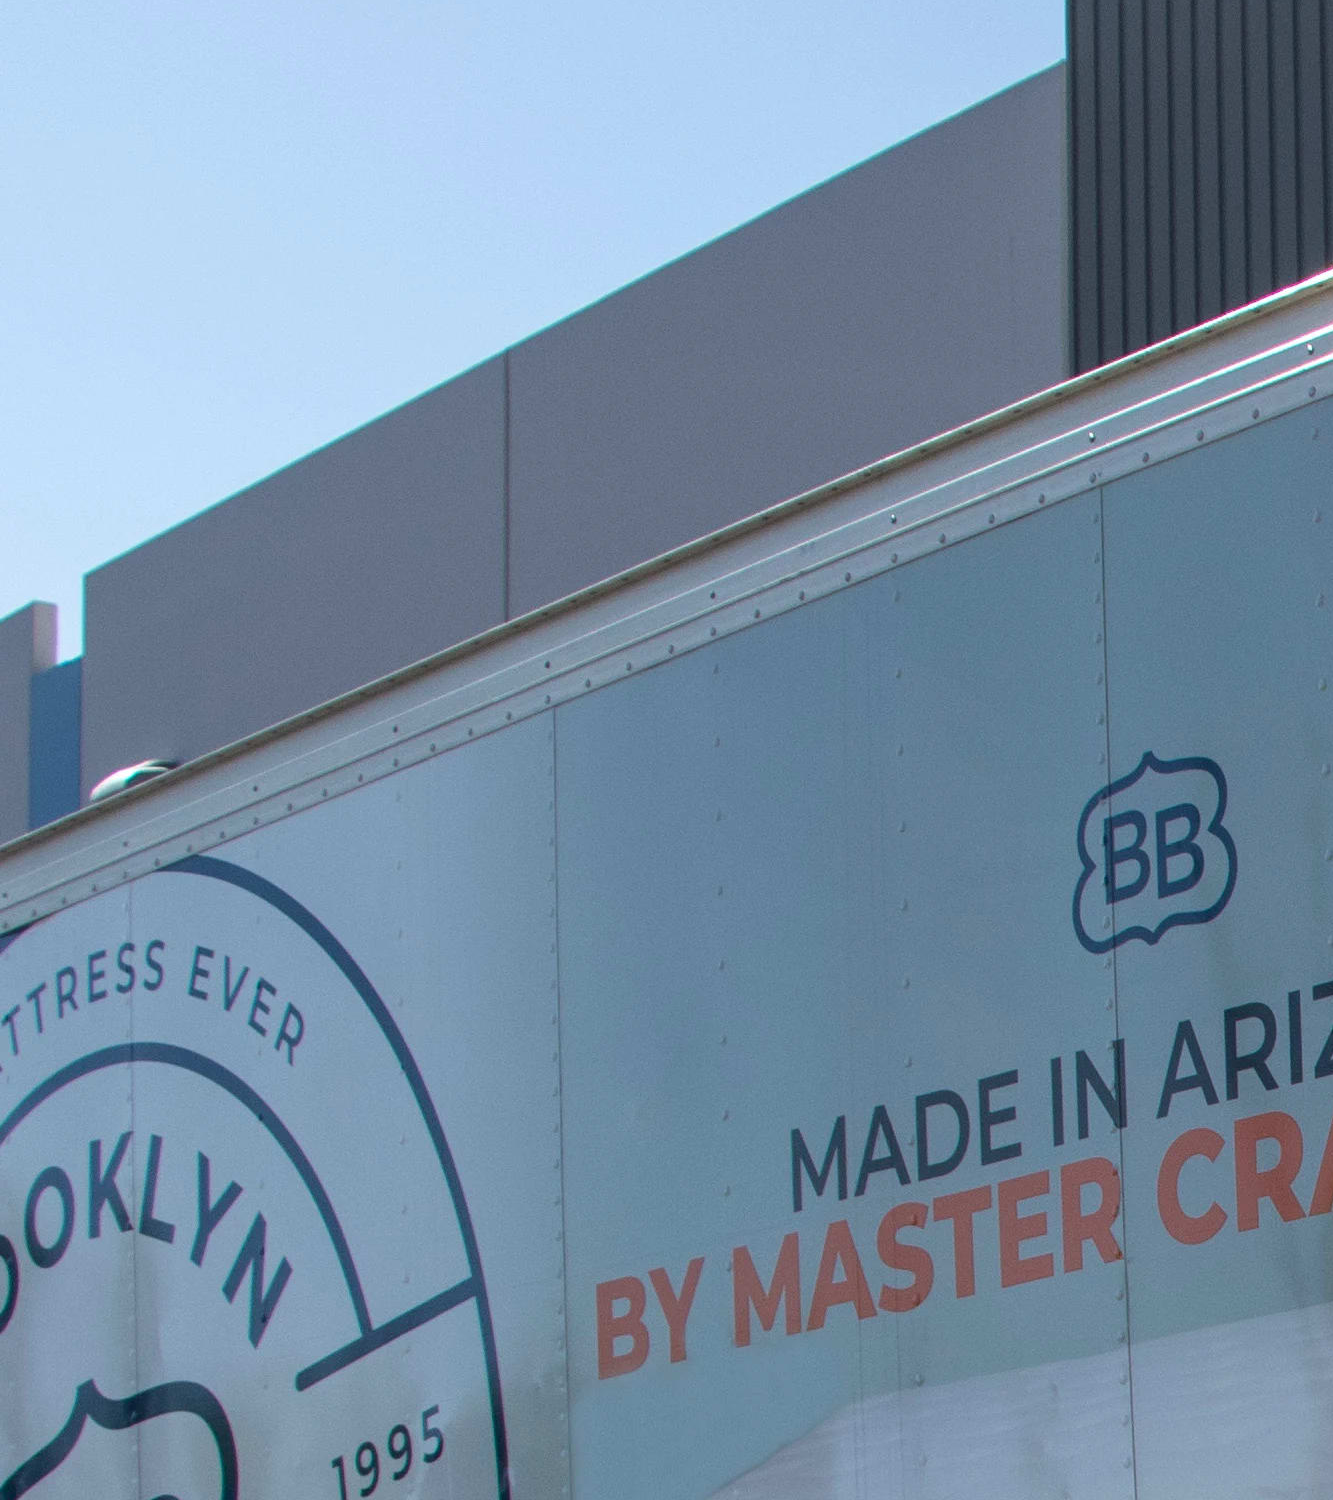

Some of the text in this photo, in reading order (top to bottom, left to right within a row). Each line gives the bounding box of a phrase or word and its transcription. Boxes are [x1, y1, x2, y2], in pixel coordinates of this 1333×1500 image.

[1103, 801, 1205, 905] BB
[0, 939, 306, 1067] TTRESS EVER
[790, 1068, 1023, 1213] MADE
[1050, 1038, 1128, 1148] IN
[595, 1256, 705, 1381] BY
[732, 1156, 1124, 1349] MASTER
